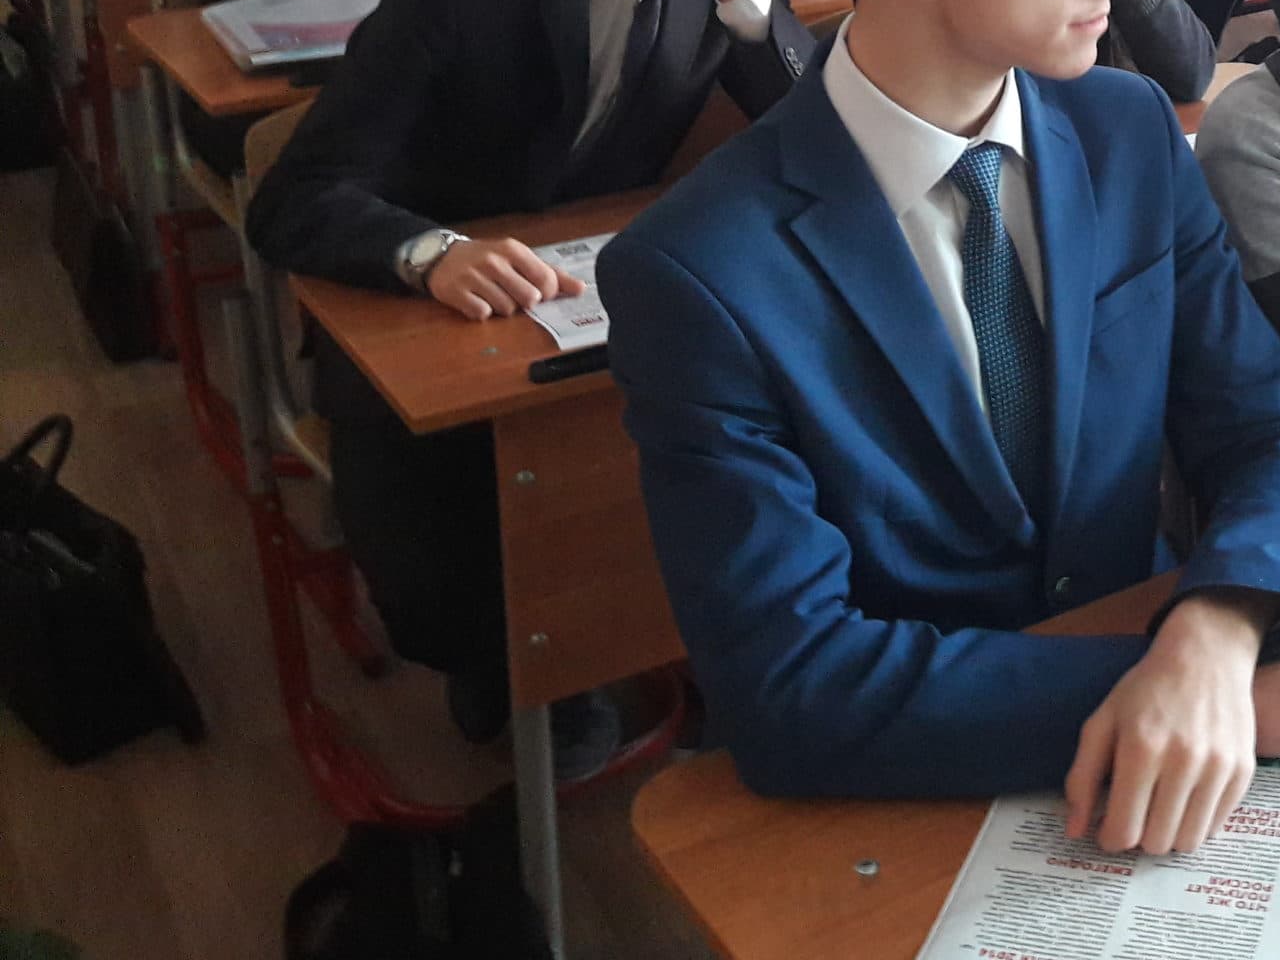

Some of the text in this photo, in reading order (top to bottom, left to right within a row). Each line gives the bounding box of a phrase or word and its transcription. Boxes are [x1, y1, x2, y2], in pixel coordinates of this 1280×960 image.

[1046, 857, 1133, 876] ЕЖЕГОДНО
[1185, 883, 1270, 902] ПОЛУЧАЕТ
[1208, 876, 1272, 893] РОССИЯ
[1207, 896, 1267, 912] ЧТО ЖЕ
